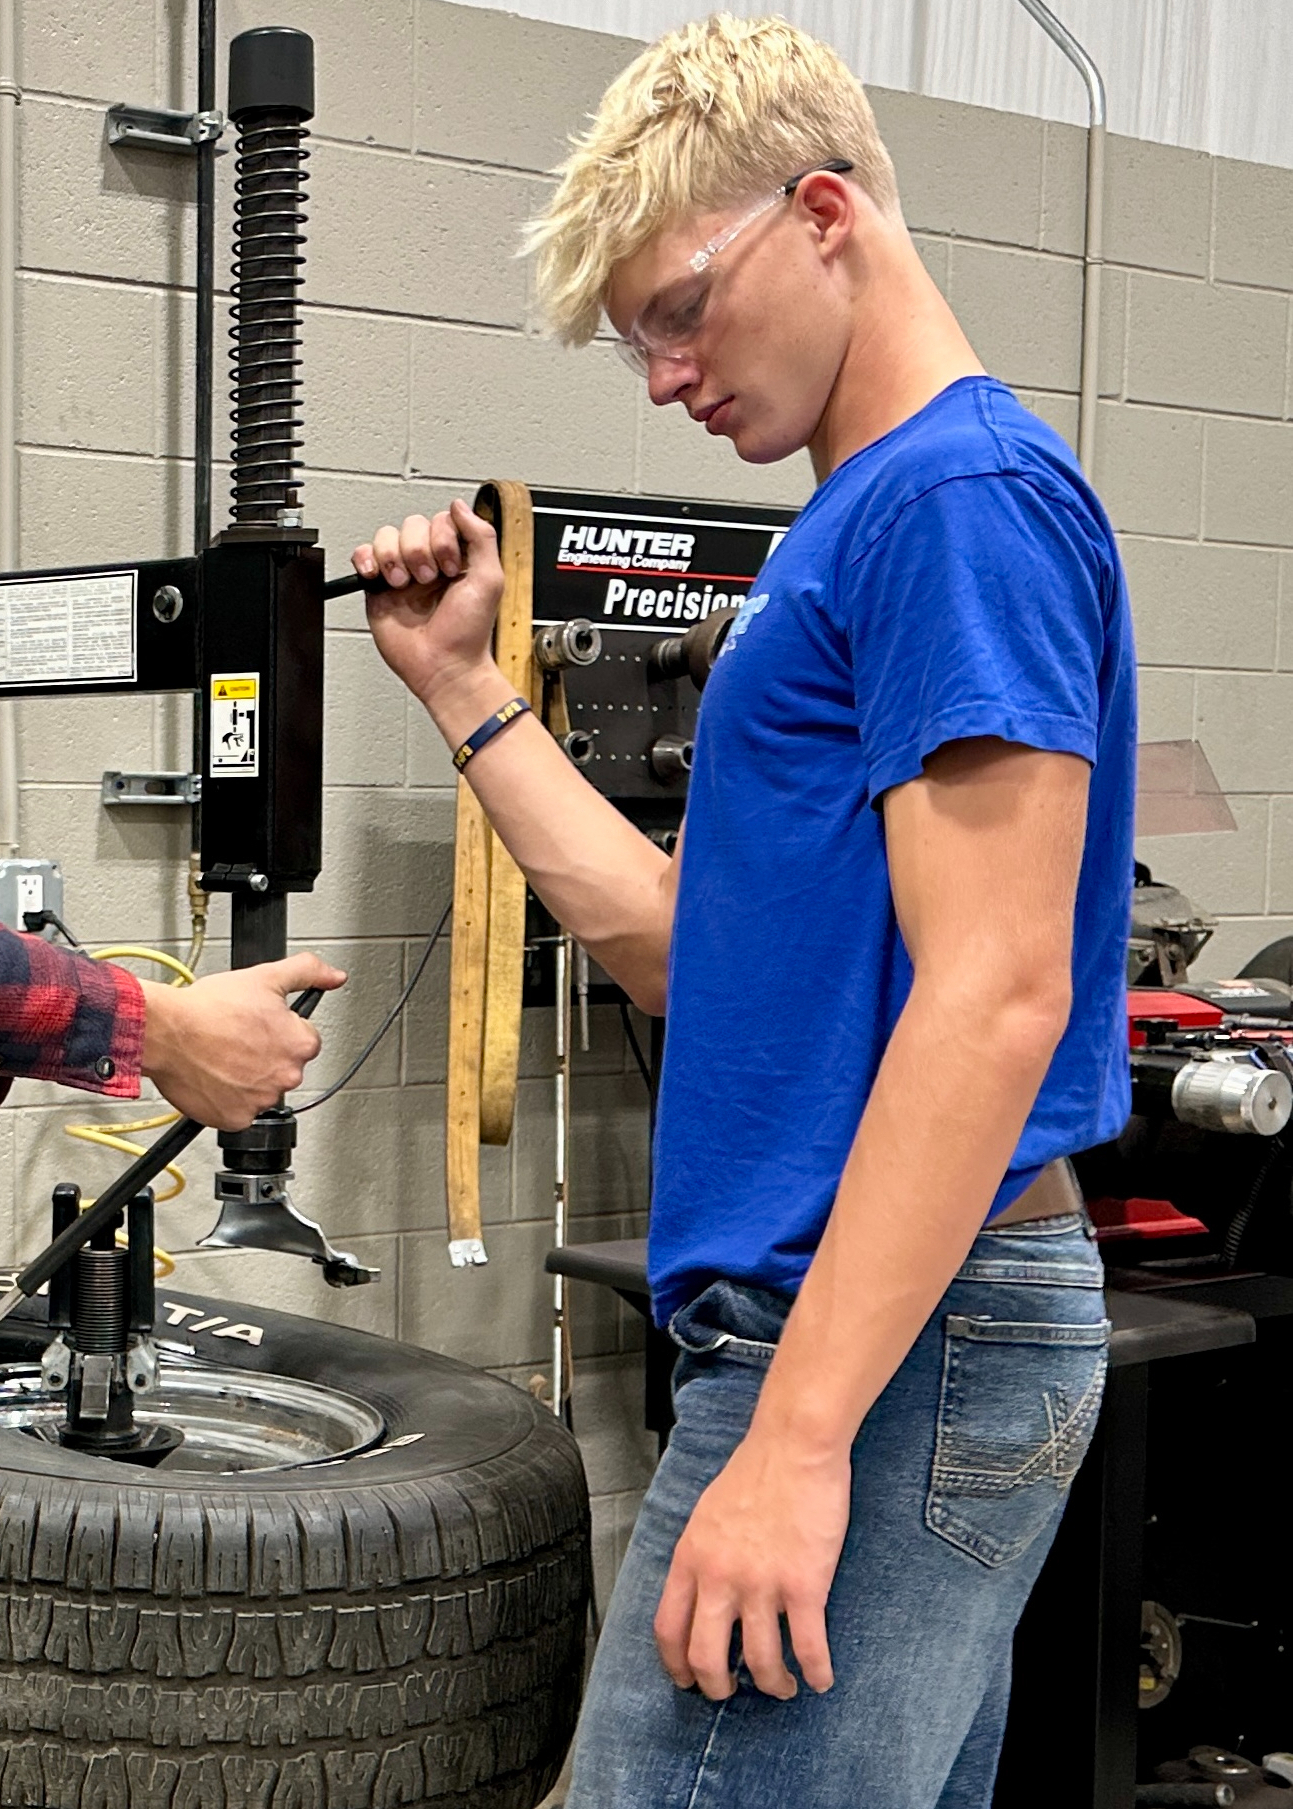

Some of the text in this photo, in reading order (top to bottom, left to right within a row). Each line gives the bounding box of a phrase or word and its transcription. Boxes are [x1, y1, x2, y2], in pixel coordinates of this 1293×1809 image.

[560, 525, 695, 557] HUNTER
[558, 548, 691, 573] Engineering Company
[163, 1302, 263, 1346] T/A
